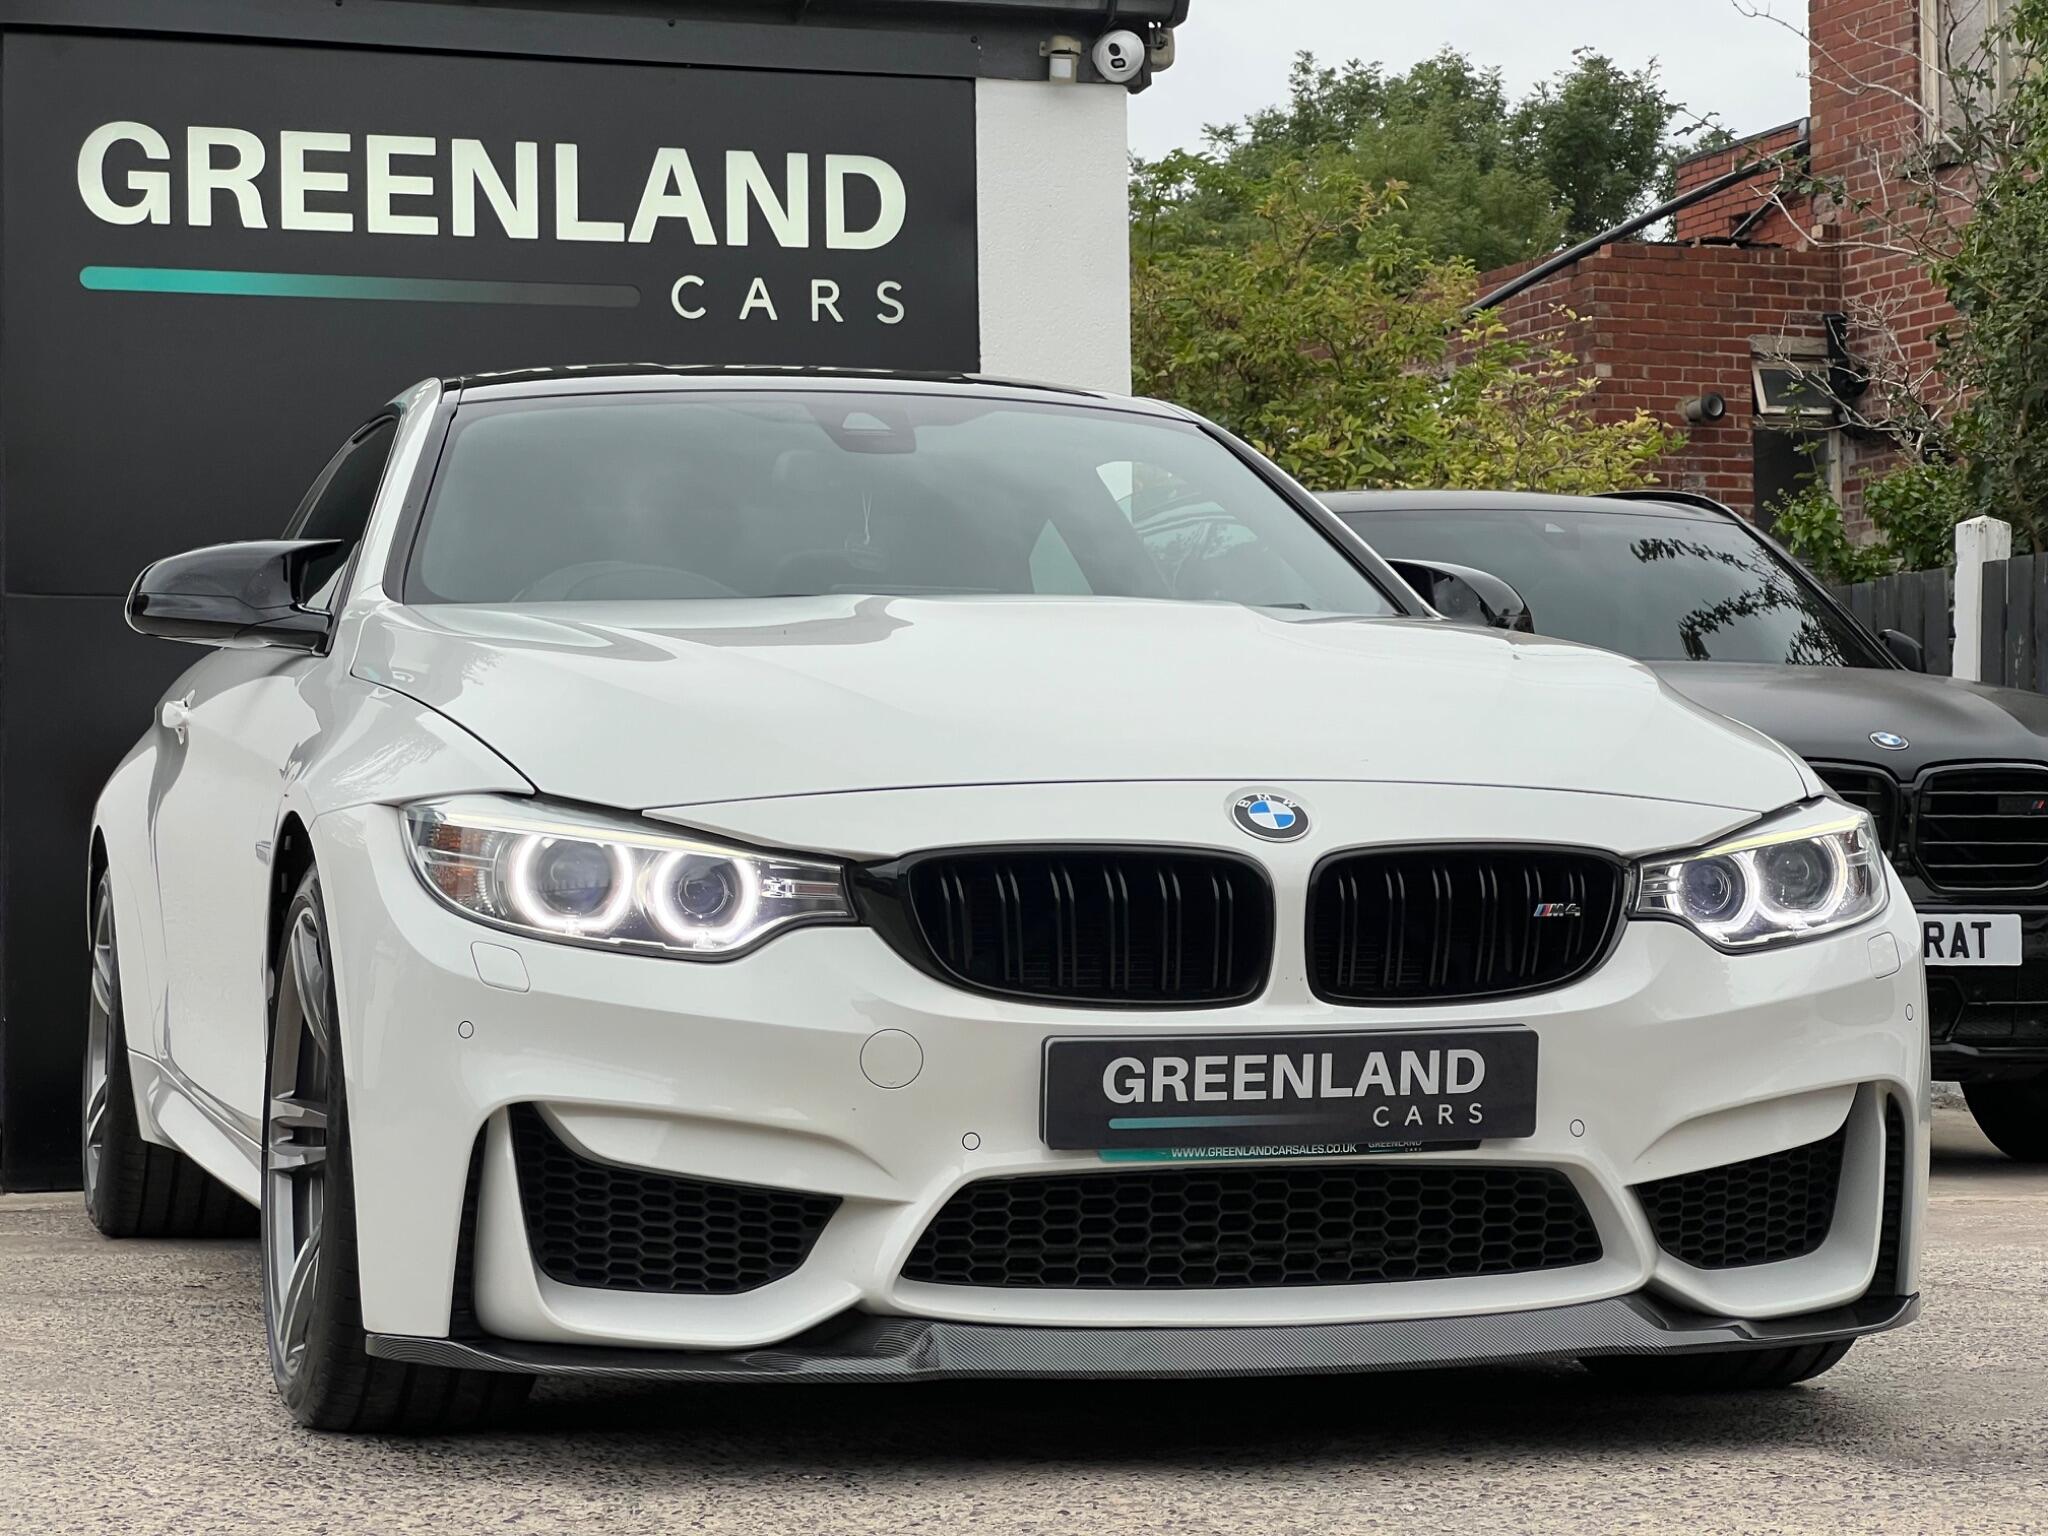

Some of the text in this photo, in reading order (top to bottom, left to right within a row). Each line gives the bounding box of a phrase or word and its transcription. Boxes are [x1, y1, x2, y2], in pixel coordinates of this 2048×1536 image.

[76, 121, 907, 251] GREENLAND
[671, 275, 906, 325] CARS
[1237, 793, 1297, 808] BMW
[1923, 921, 1992, 959] RAT
[1102, 1048, 1486, 1104] GREENLAND
[1373, 1103, 1484, 1128] CARS
[1171, 1143, 1358, 1158] WWW.GREENLANDCARSALES.CO.UK
